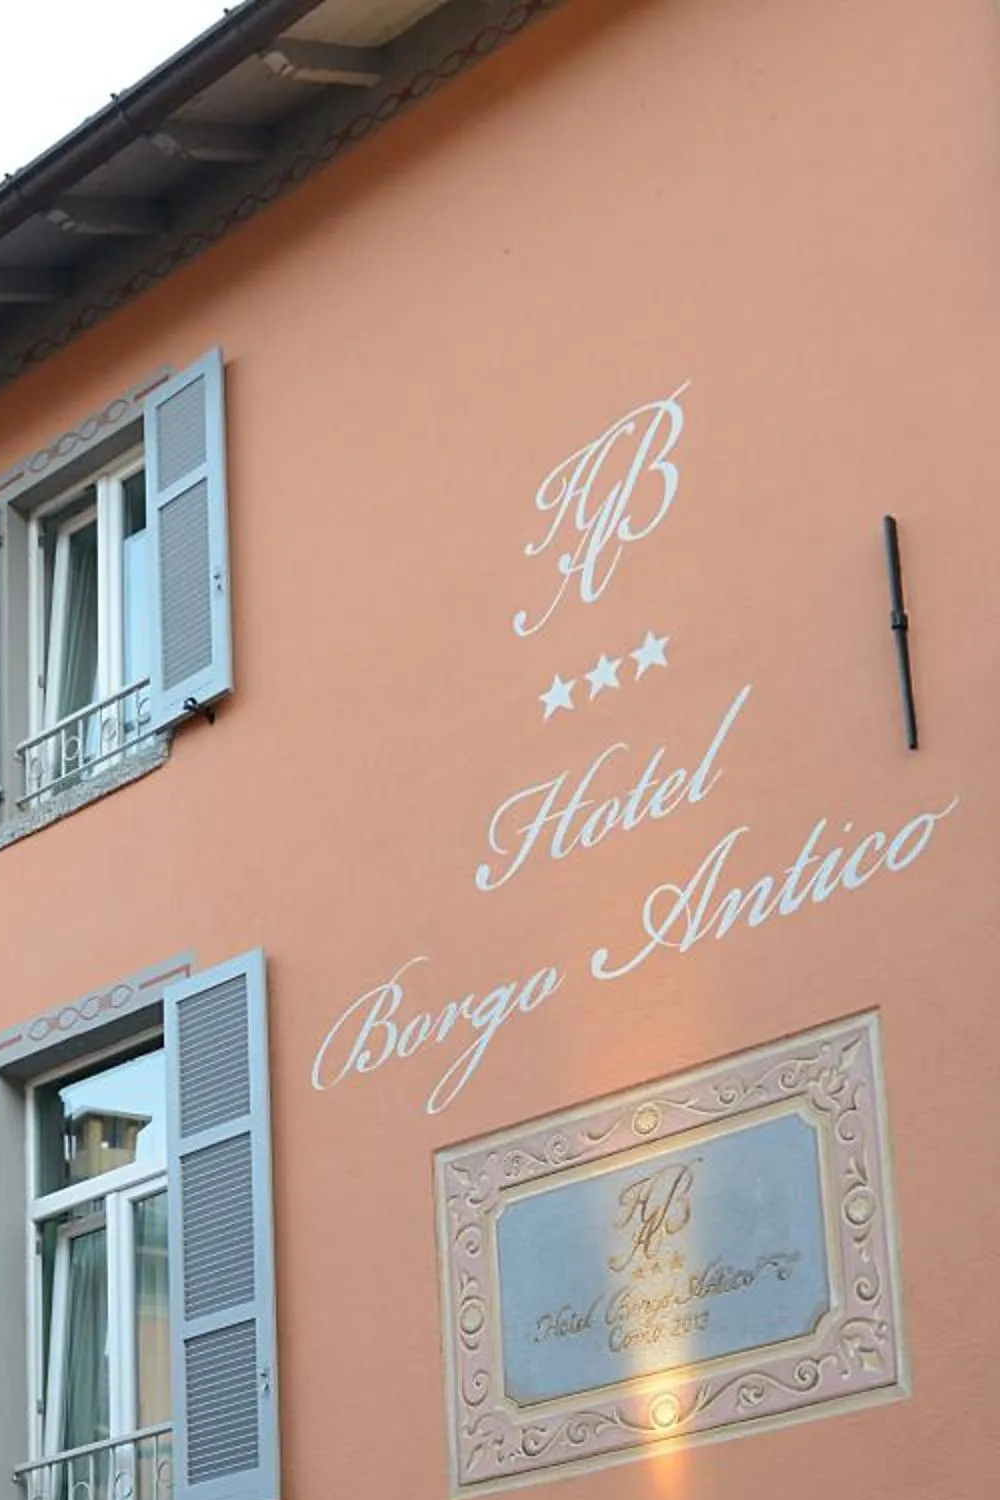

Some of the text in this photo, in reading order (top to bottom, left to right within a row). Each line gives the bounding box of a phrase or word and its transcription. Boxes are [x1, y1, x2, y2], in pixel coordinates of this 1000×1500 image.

[475, 685, 752, 892] Hotel
[310, 796, 960, 1116] Borgo Antico
